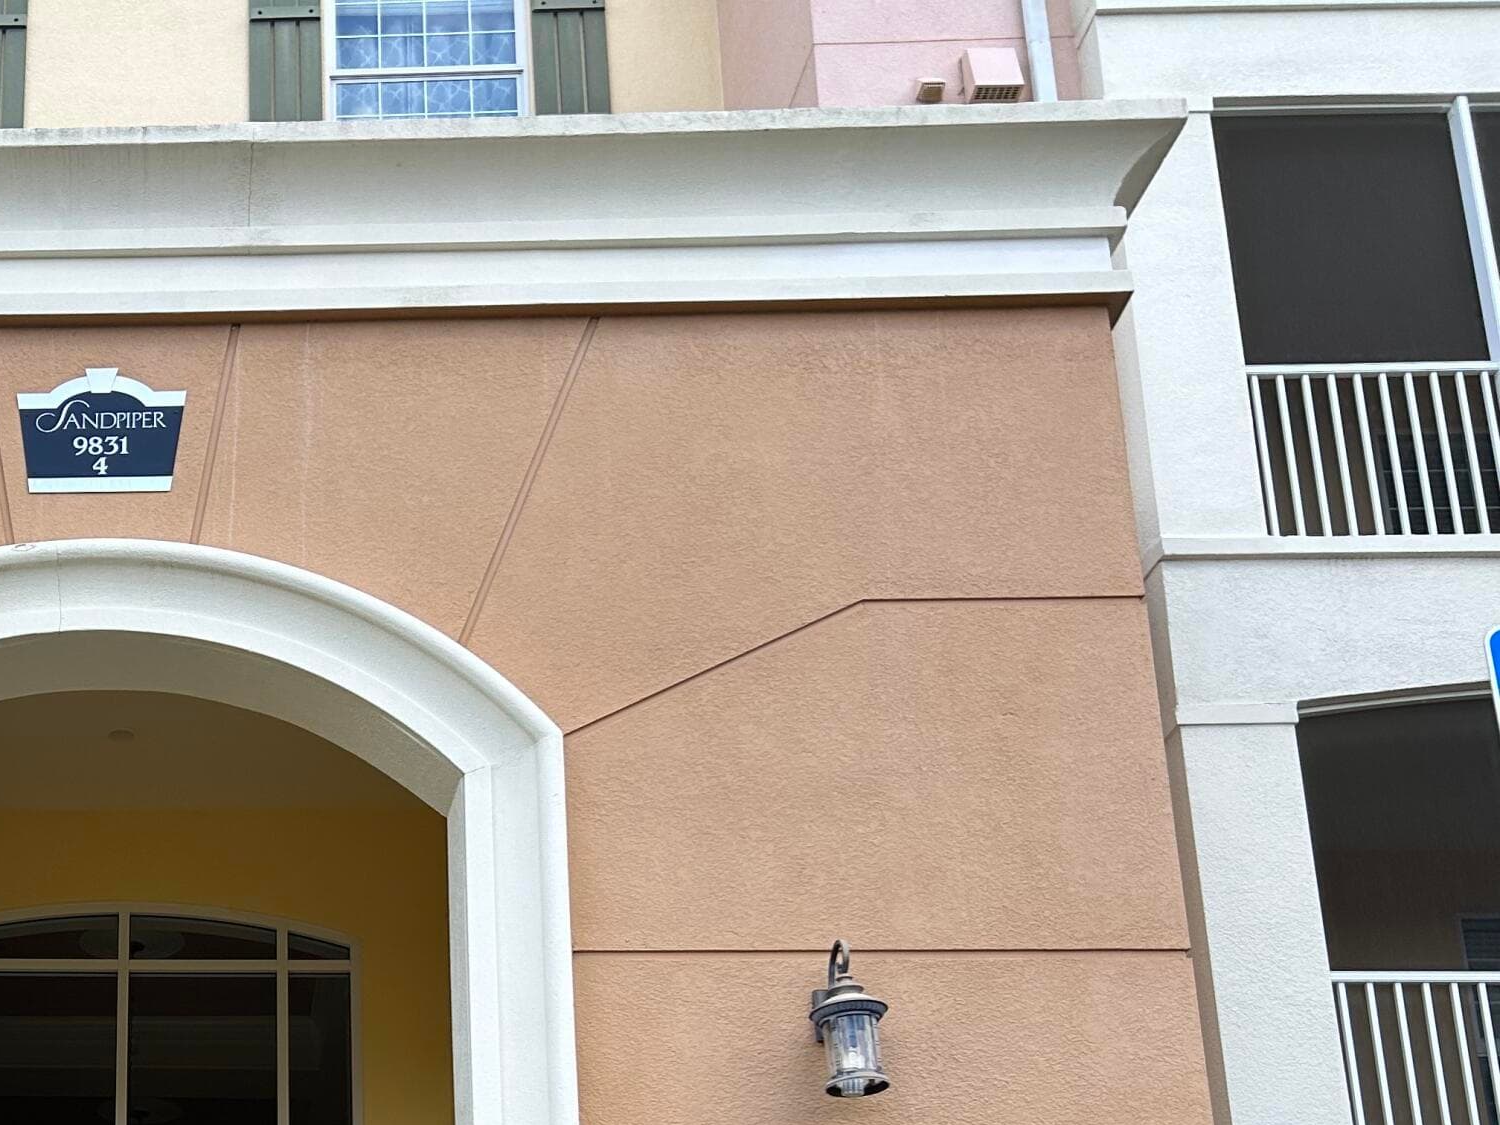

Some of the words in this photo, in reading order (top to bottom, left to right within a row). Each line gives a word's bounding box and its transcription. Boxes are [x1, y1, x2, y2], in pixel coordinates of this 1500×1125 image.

[36, 400, 166, 432] SANDPIPER
[73, 436, 128, 456] 9831
[92, 457, 108, 475] 4
